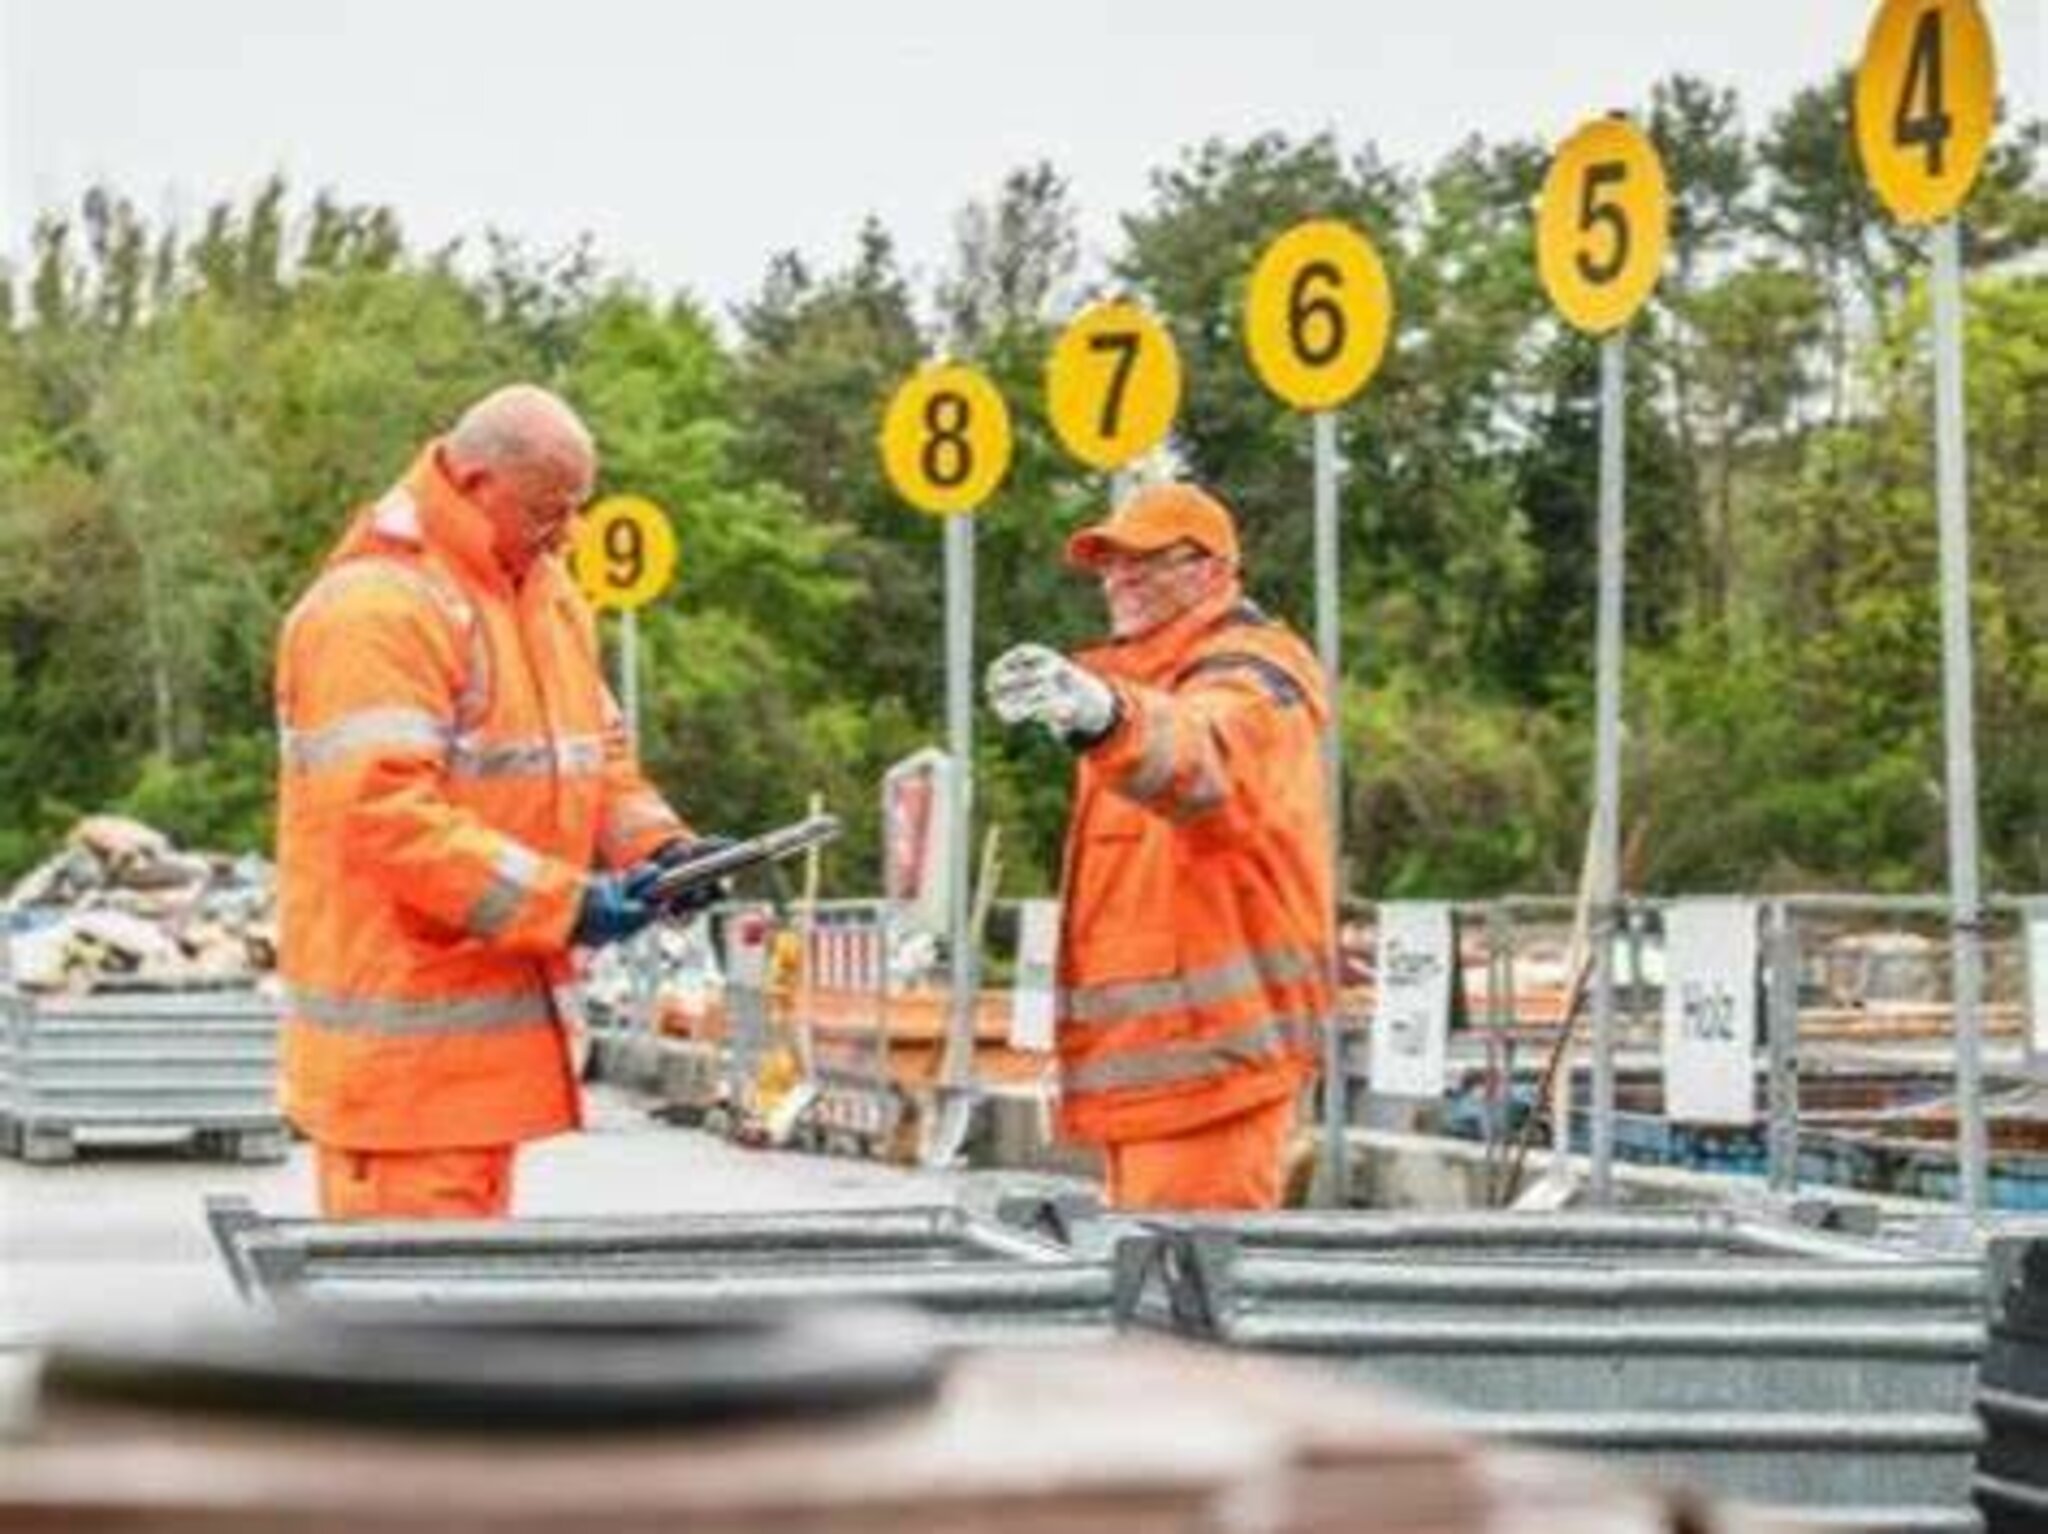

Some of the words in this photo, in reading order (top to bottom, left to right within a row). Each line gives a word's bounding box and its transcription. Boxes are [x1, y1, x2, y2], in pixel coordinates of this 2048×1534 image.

[1893, 6, 1953, 177] 4
[1576, 161, 1629, 285] 5
[1288, 261, 1345, 368] 6
[1090, 331, 1139, 438] 7
[922, 391, 972, 488] 8
[604, 518, 643, 589] 9
